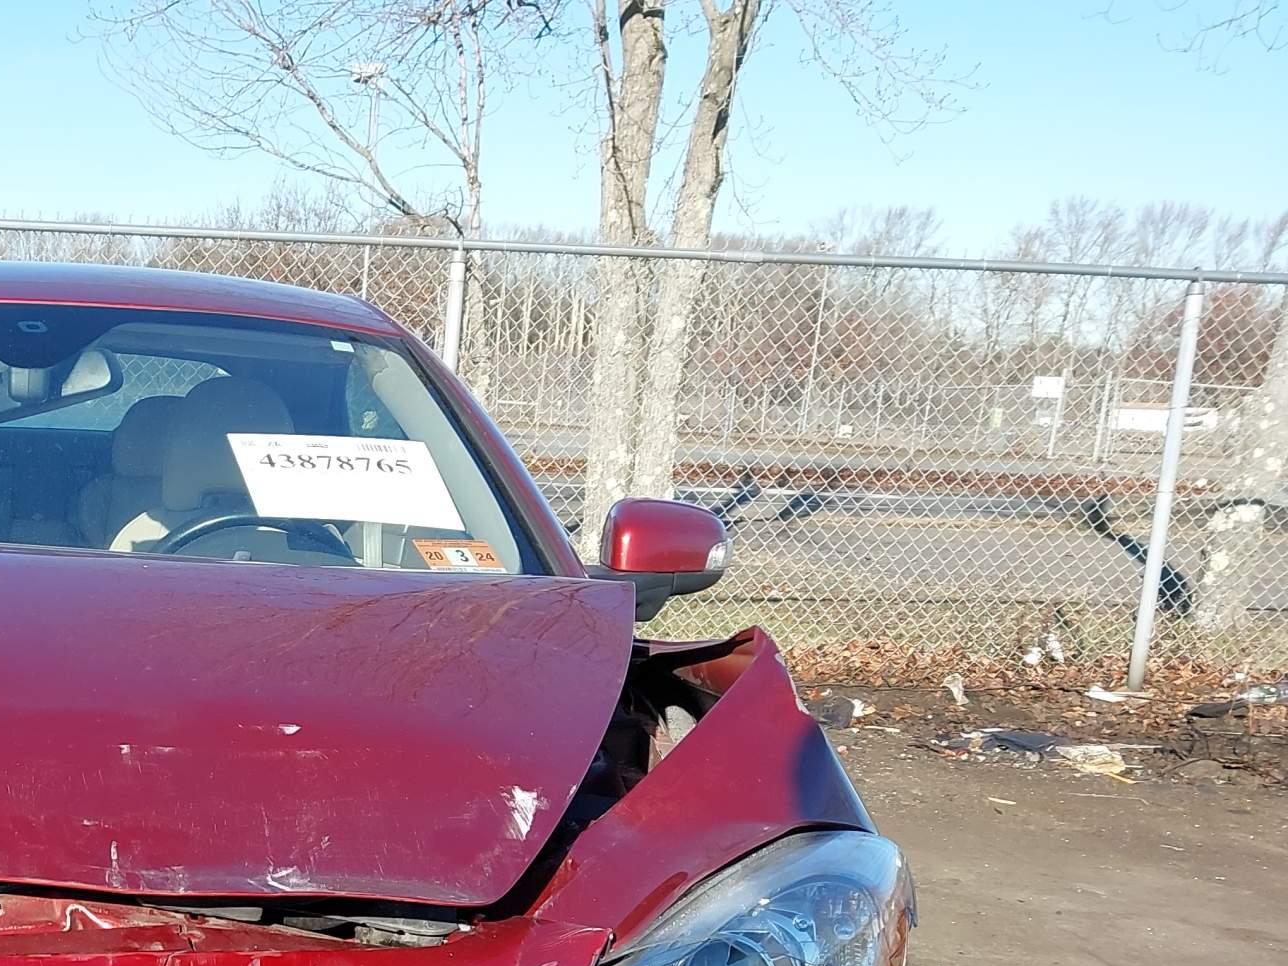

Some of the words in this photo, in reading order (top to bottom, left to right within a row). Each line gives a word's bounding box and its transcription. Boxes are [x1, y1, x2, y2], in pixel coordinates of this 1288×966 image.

[259, 453, 413, 475] 43878765
[425, 550, 444, 561] 20
[455, 549, 469, 563] 3
[475, 552, 495, 562] 24
